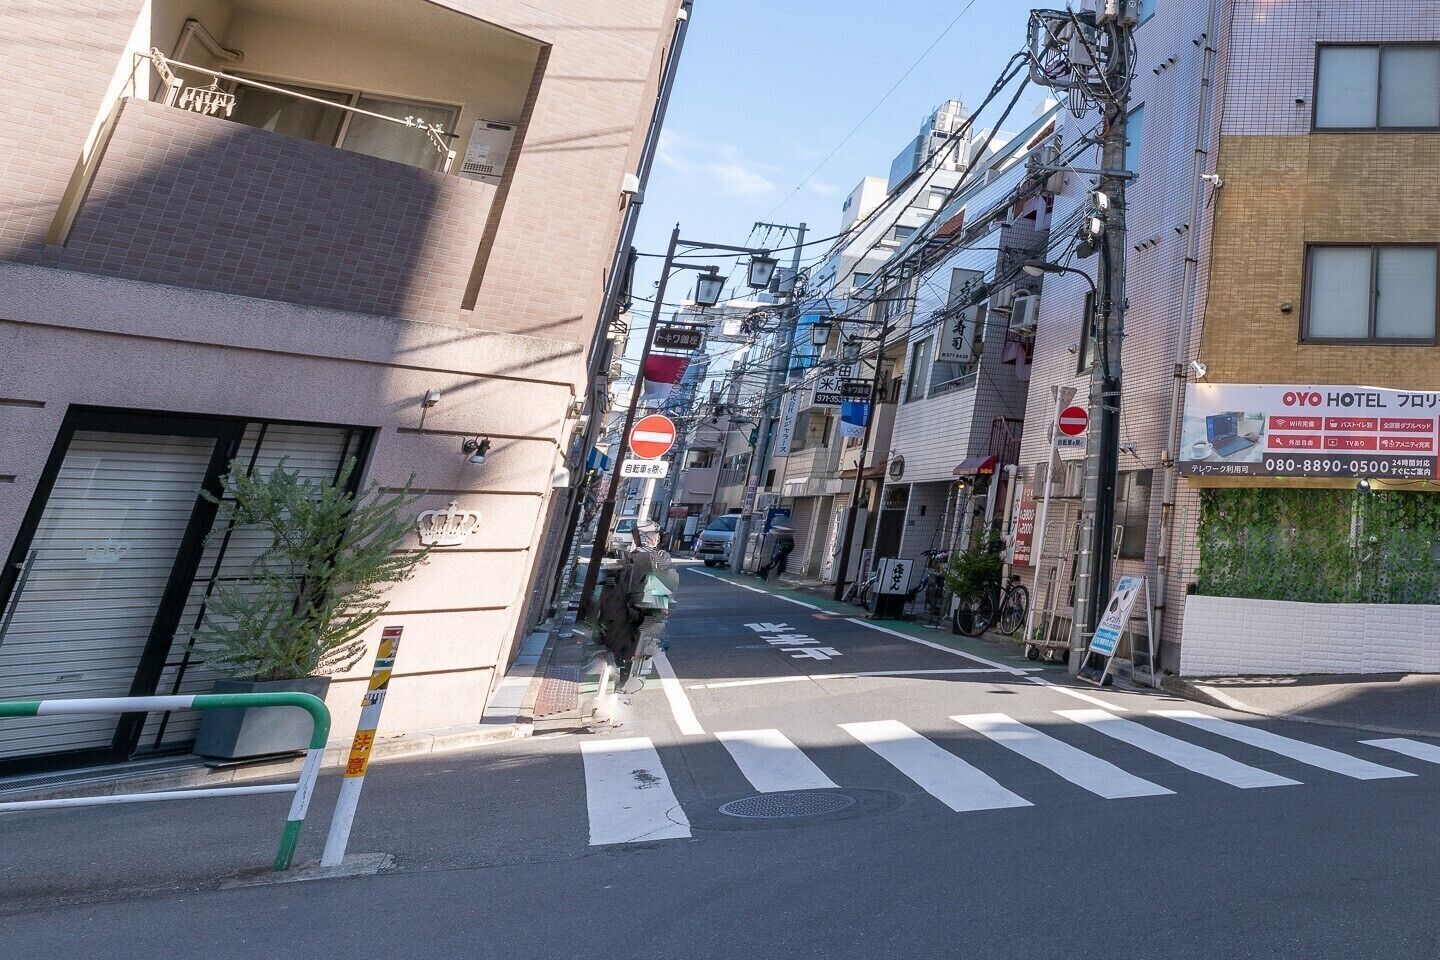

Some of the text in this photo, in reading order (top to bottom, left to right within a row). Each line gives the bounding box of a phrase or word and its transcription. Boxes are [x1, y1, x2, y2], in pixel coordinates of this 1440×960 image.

[656, 332, 700, 346] トキワ銀座
[1282, 391, 1323, 407] OYO
[1327, 392, 1387, 408] HOTEL
[1340, 421, 1373, 429] バストイレ別
[1383, 421, 1432, 430] 全部屋ダブルベッド
[1288, 438, 1314, 447] 外出自由
[1345, 439, 1365, 447] TVあり
[1394, 441, 1431, 449] アメニティ充実
[1265, 458, 1389, 473] 080-8890-0500
[1392, 459, 1431, 467] 24時間対応
[625, 463, 664, 475] 自転車を除く
[1191, 464, 1249, 474] テレワーク利用可
[1391, 467, 1431, 476] すぐにご案内
[345, 733, 372, 776] 注意
